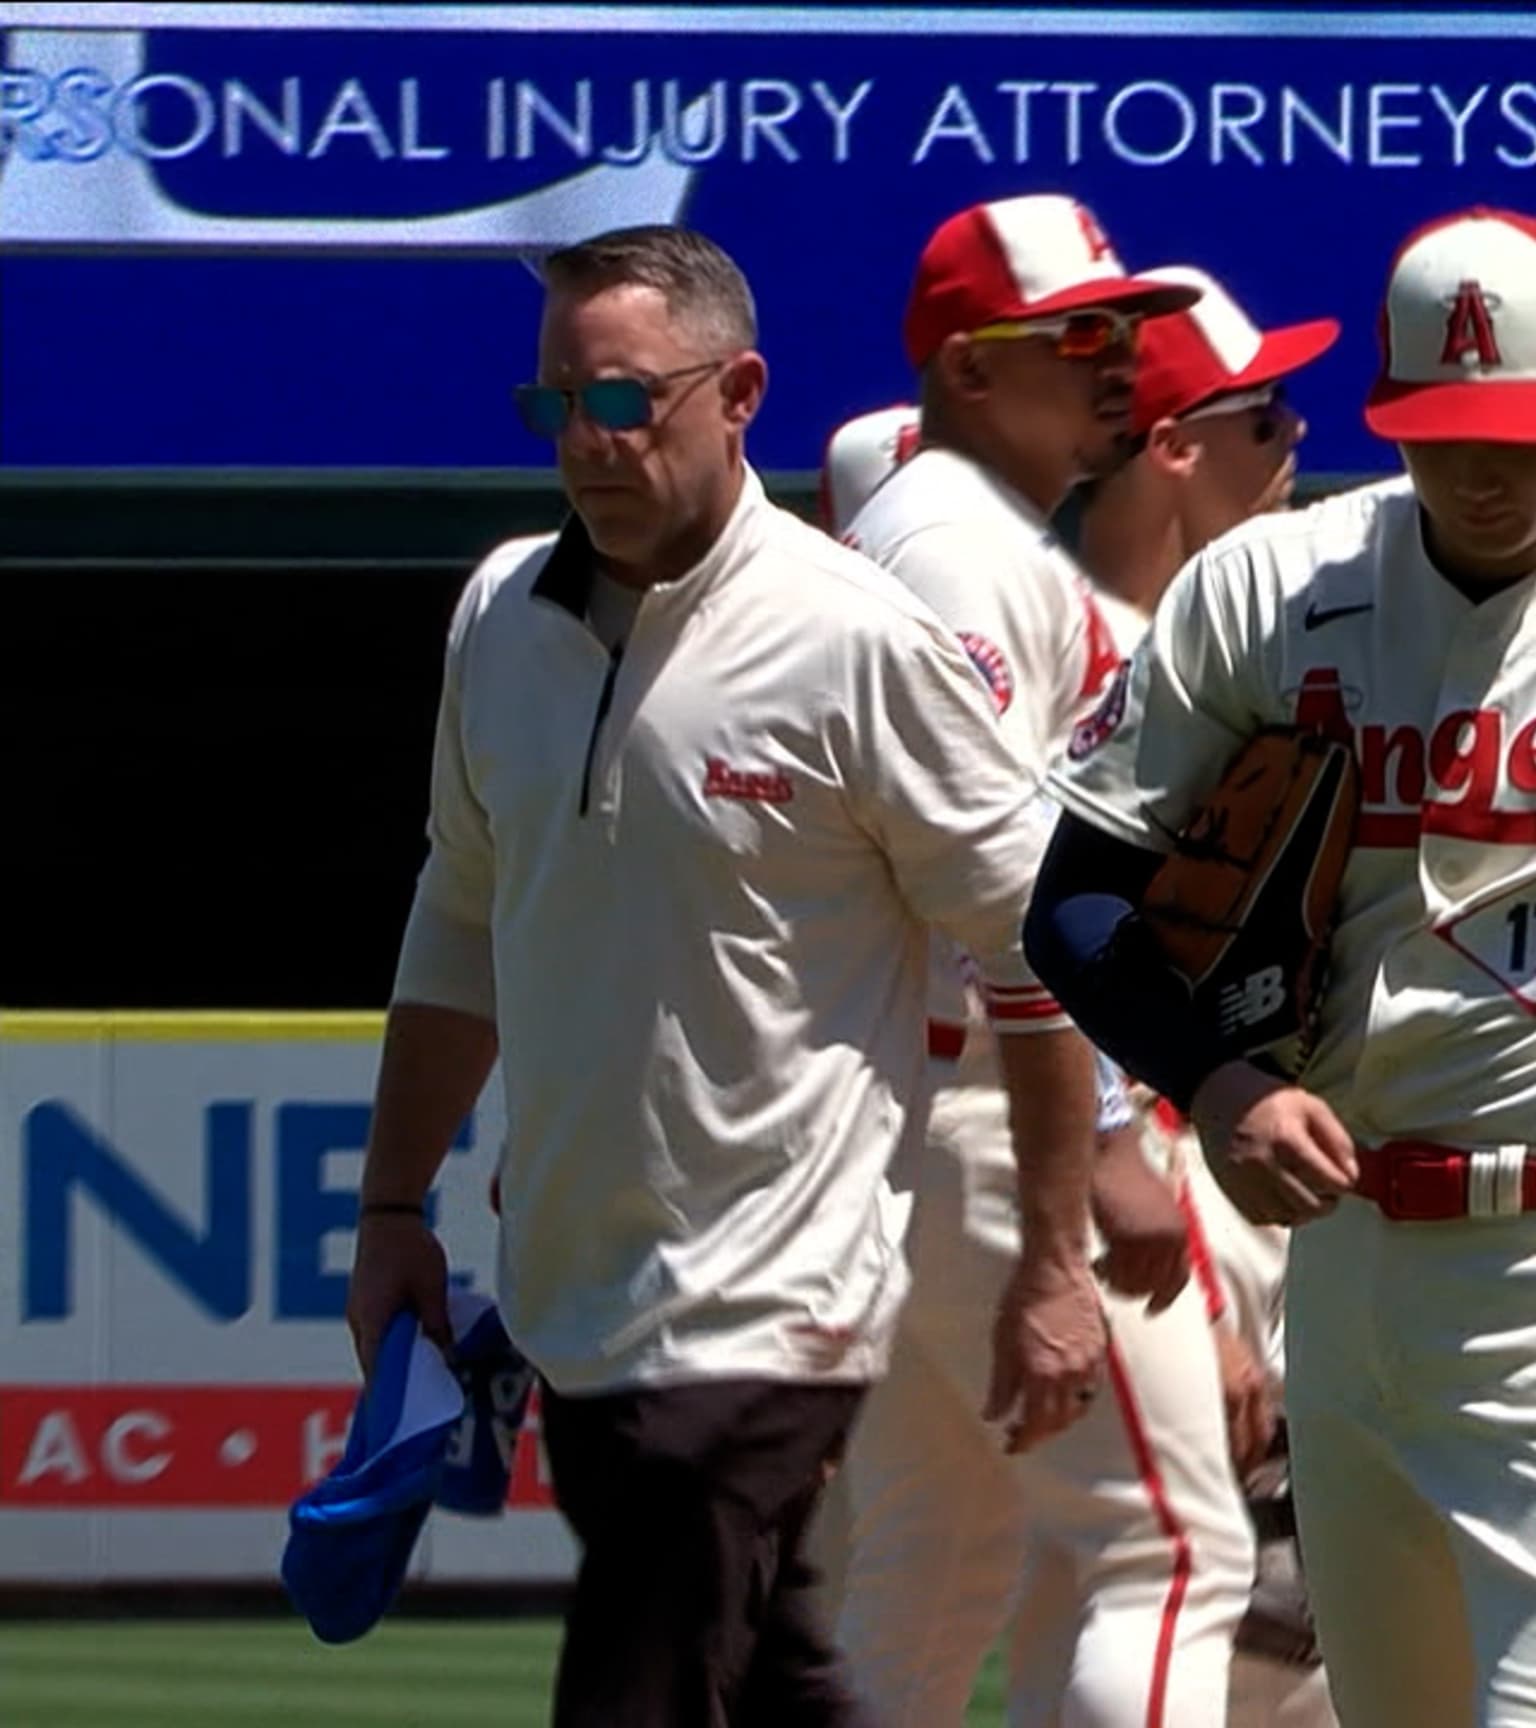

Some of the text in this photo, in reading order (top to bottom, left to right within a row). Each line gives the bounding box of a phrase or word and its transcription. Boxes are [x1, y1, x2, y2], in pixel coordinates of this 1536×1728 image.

[487, 77, 873, 165] INJURY
[1440, 278, 1502, 368] A
[17, 1409, 176, 1484] AC
